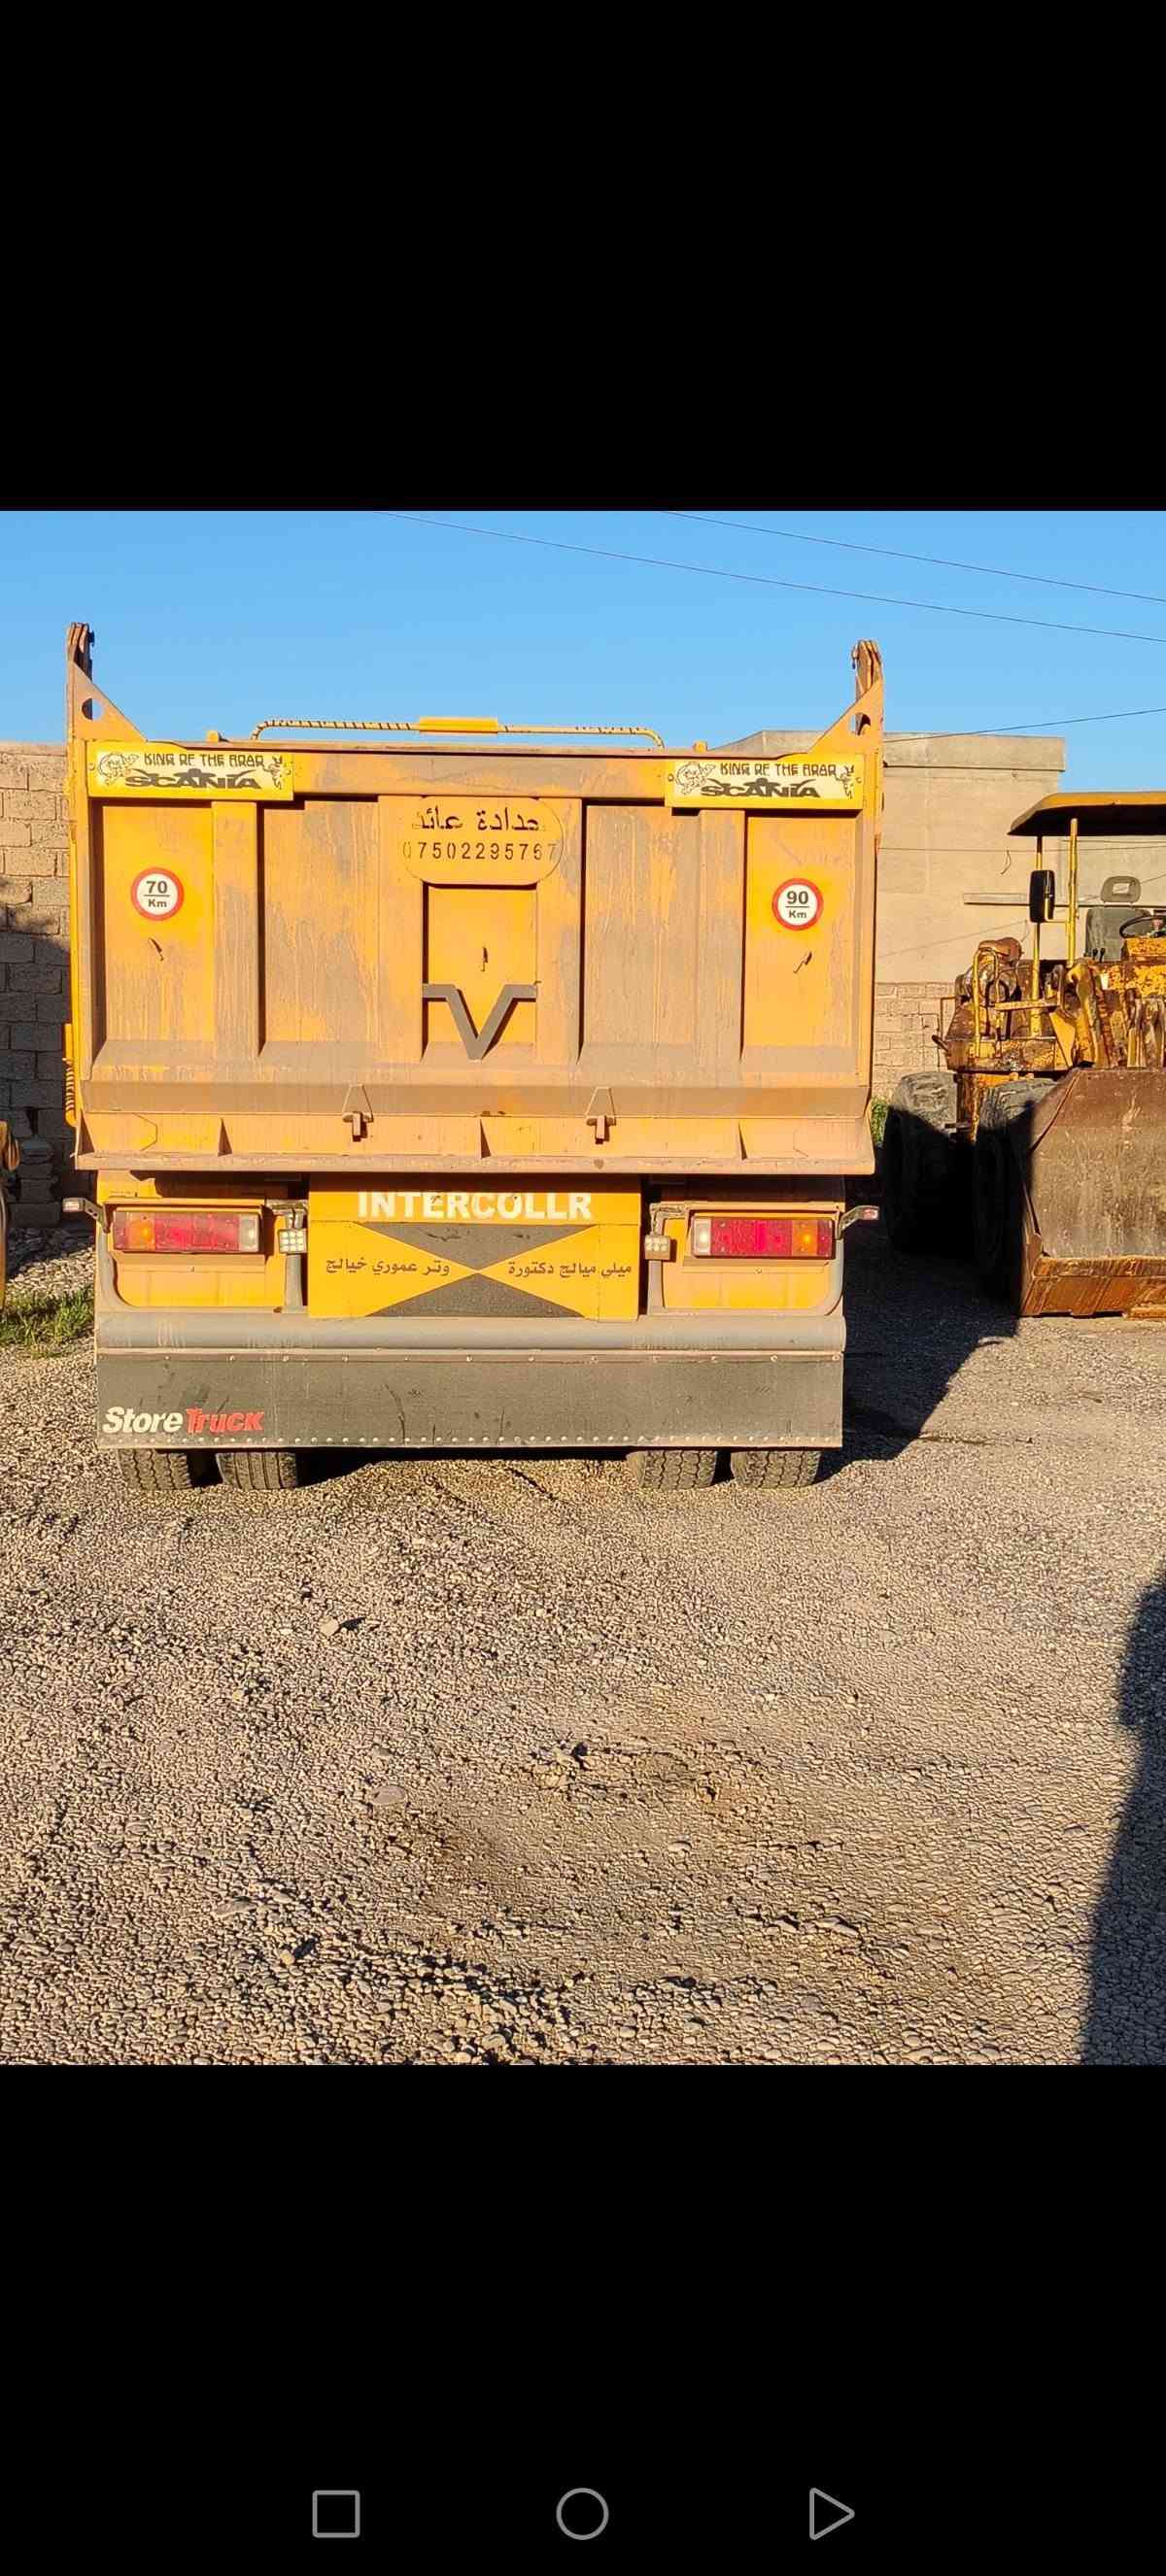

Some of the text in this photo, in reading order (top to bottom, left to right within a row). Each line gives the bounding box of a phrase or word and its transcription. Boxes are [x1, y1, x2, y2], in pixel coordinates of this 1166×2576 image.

[124, 772, 261, 789] SCANIA
[701, 782, 820, 798] SCANIA
[146, 880, 168, 894] 70
[148, 898, 167, 907] Km
[786, 890, 808, 904] 90
[788, 909, 807, 919] Km
[102, 1406, 184, 1434] Store
